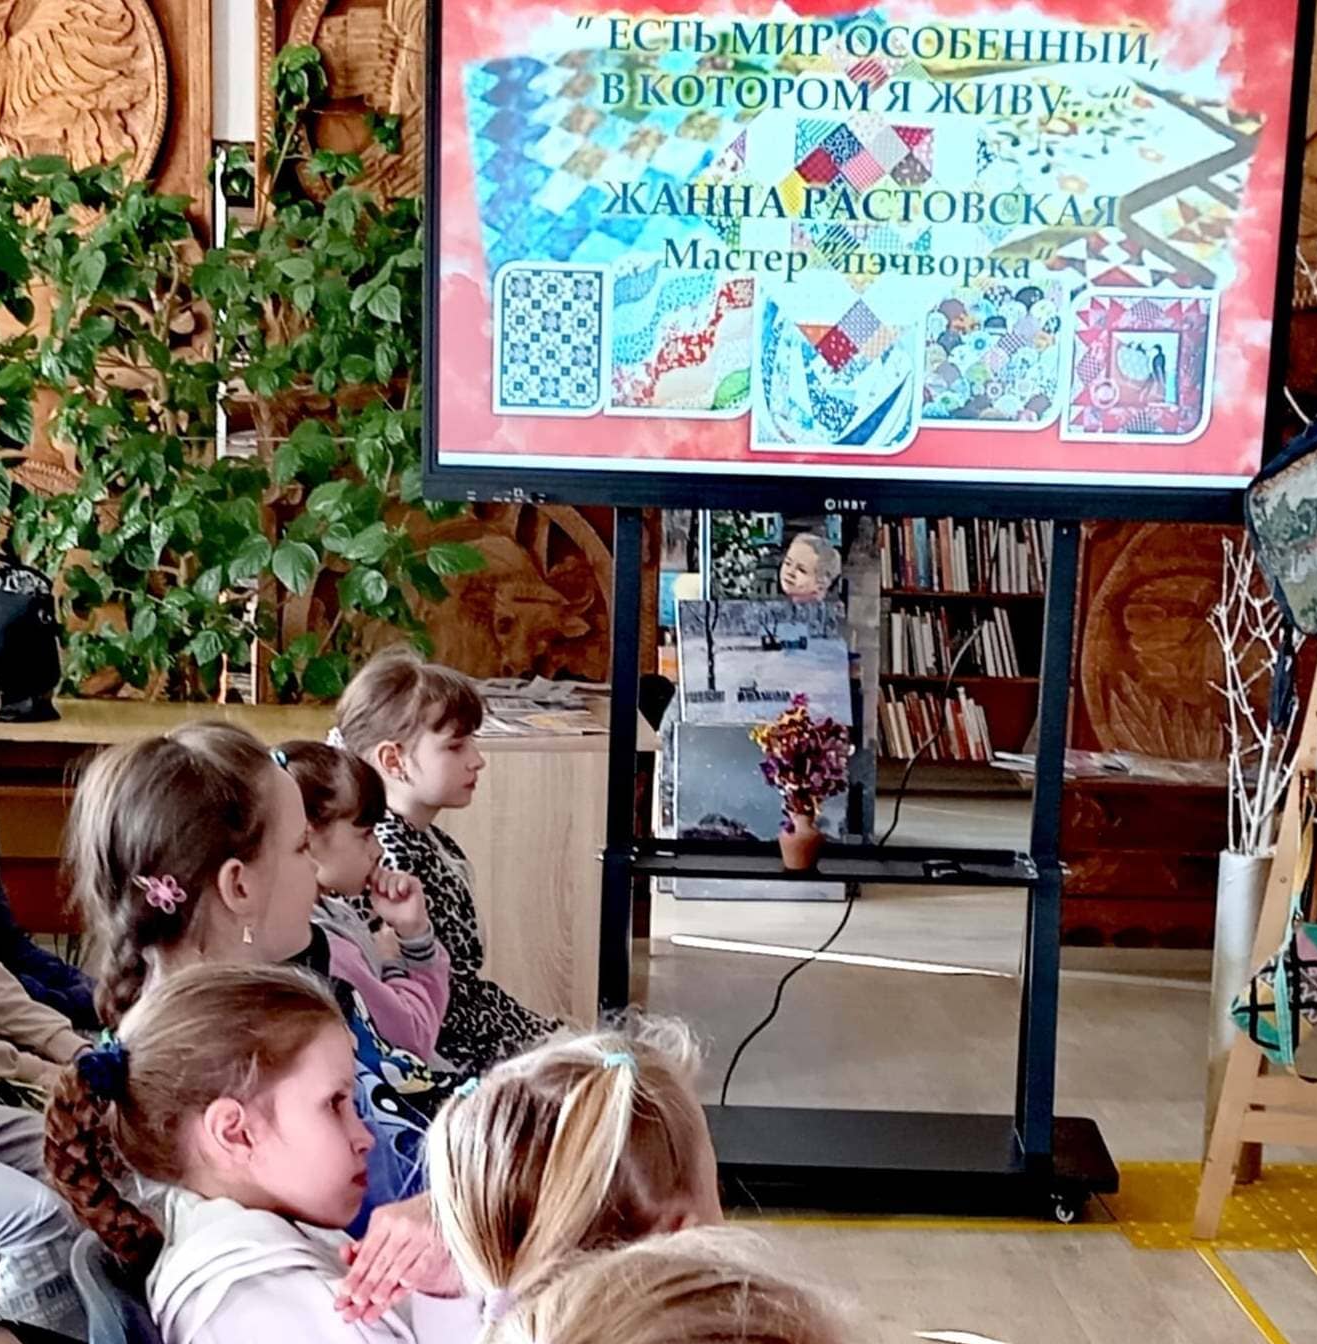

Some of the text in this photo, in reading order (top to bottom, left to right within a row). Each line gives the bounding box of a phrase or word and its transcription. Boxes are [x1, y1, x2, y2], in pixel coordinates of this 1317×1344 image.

[608, 18, 717, 53] ЕСТЬ
[731, 22, 832, 57] МИР
[845, 23, 1159, 71] ОСОБЕННЫЙ,
[600, 72, 625, 105] В
[637, 74, 870, 112] КОТОРОМ
[884, 81, 911, 112] Я
[600, 181, 1119, 227] ЖАННА РАСТОВСКАЯ
[661, 237, 1054, 288] Мастер "пэчворка"
